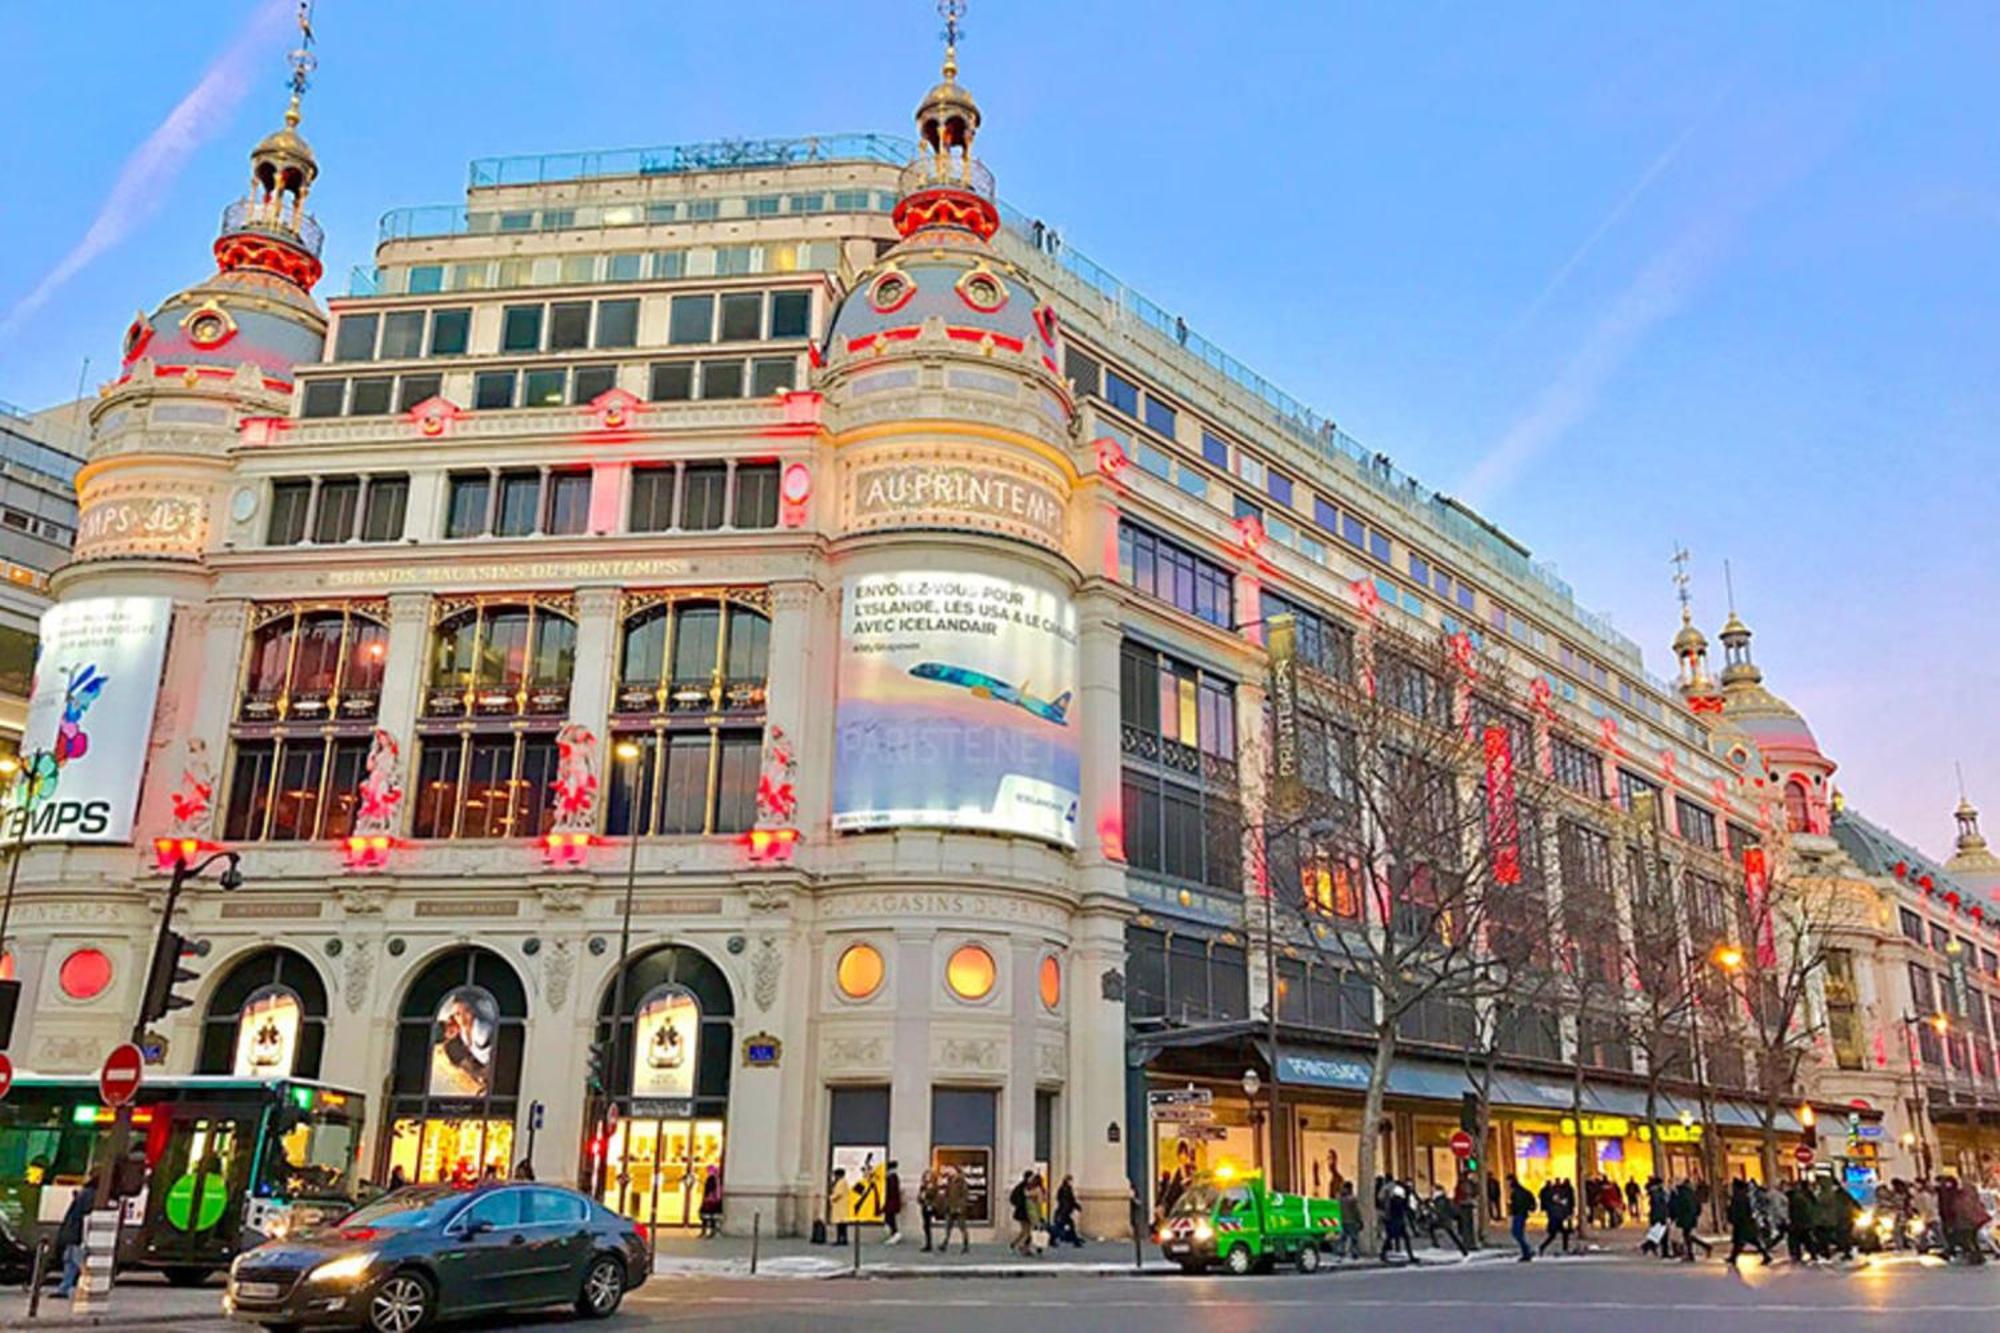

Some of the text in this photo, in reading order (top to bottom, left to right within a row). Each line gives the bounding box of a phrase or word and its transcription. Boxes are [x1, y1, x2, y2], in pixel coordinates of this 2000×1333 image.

[425, 564, 527, 582] MAGASINS
[531, 562, 559, 578] DU
[564, 559, 679, 578] PRINTEMPS
[983, 586, 1025, 607] POUR
[944, 601, 974, 616] LES
[979, 604, 1009, 621] USA
[1013, 610, 1022, 624] &
[1025, 613, 1040, 629] LE
[853, 617, 998, 636] AVEC ICELANDAIR
